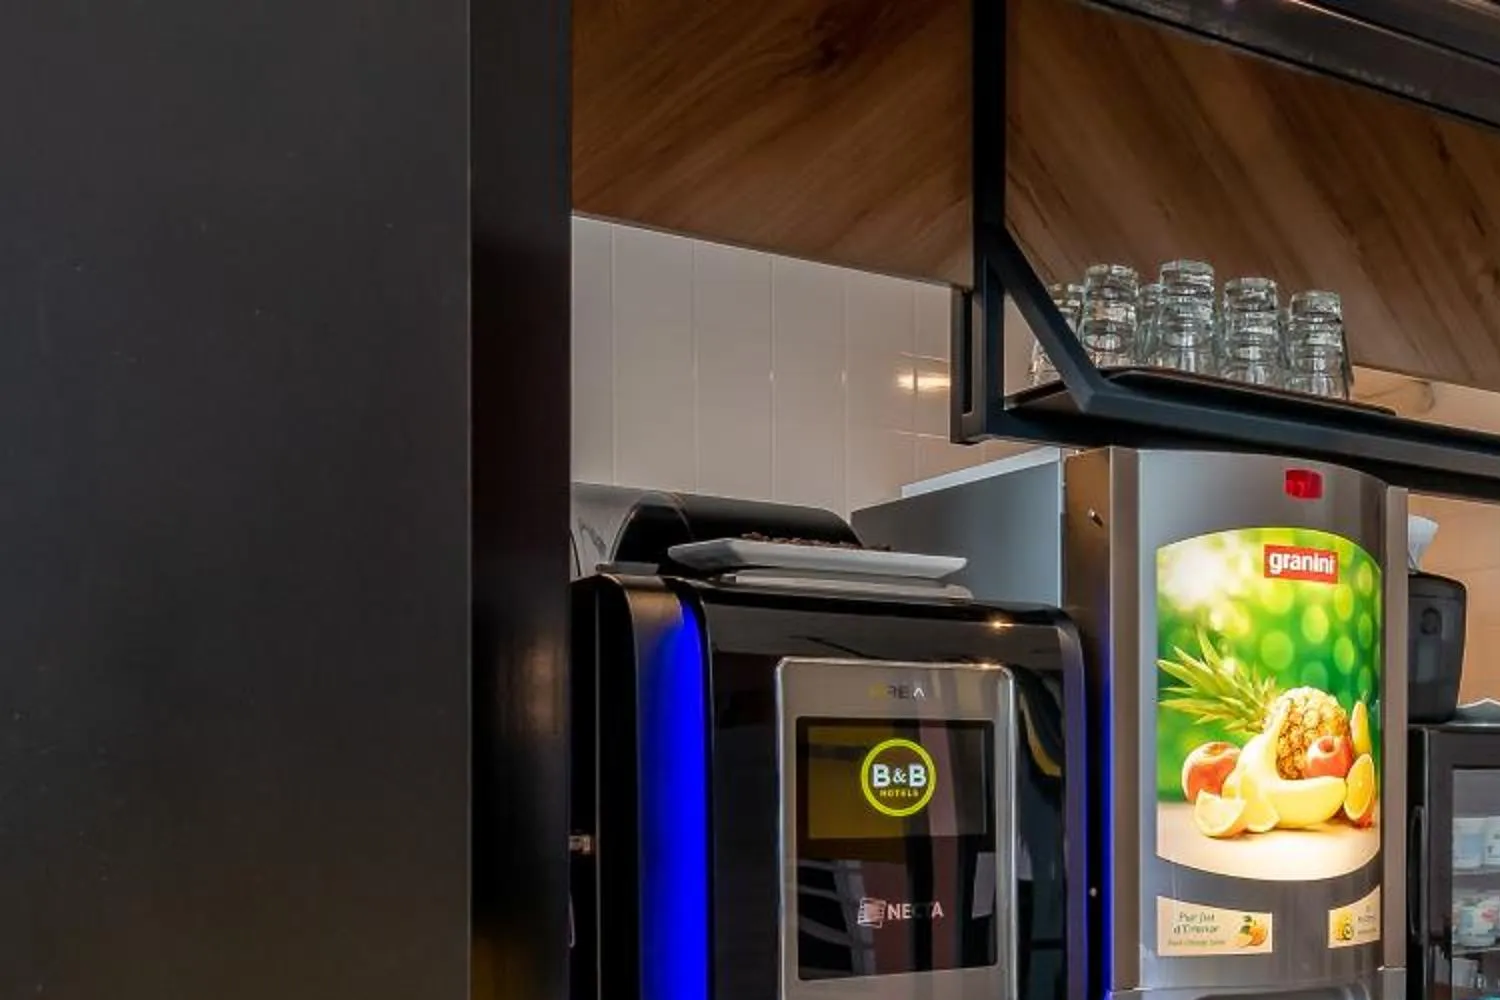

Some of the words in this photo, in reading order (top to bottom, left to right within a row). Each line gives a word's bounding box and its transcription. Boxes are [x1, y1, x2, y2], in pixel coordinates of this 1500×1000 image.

[1269, 551, 1335, 575] granini
[872, 763, 926, 788] B&B
[879, 788, 920, 798] HOTELS
